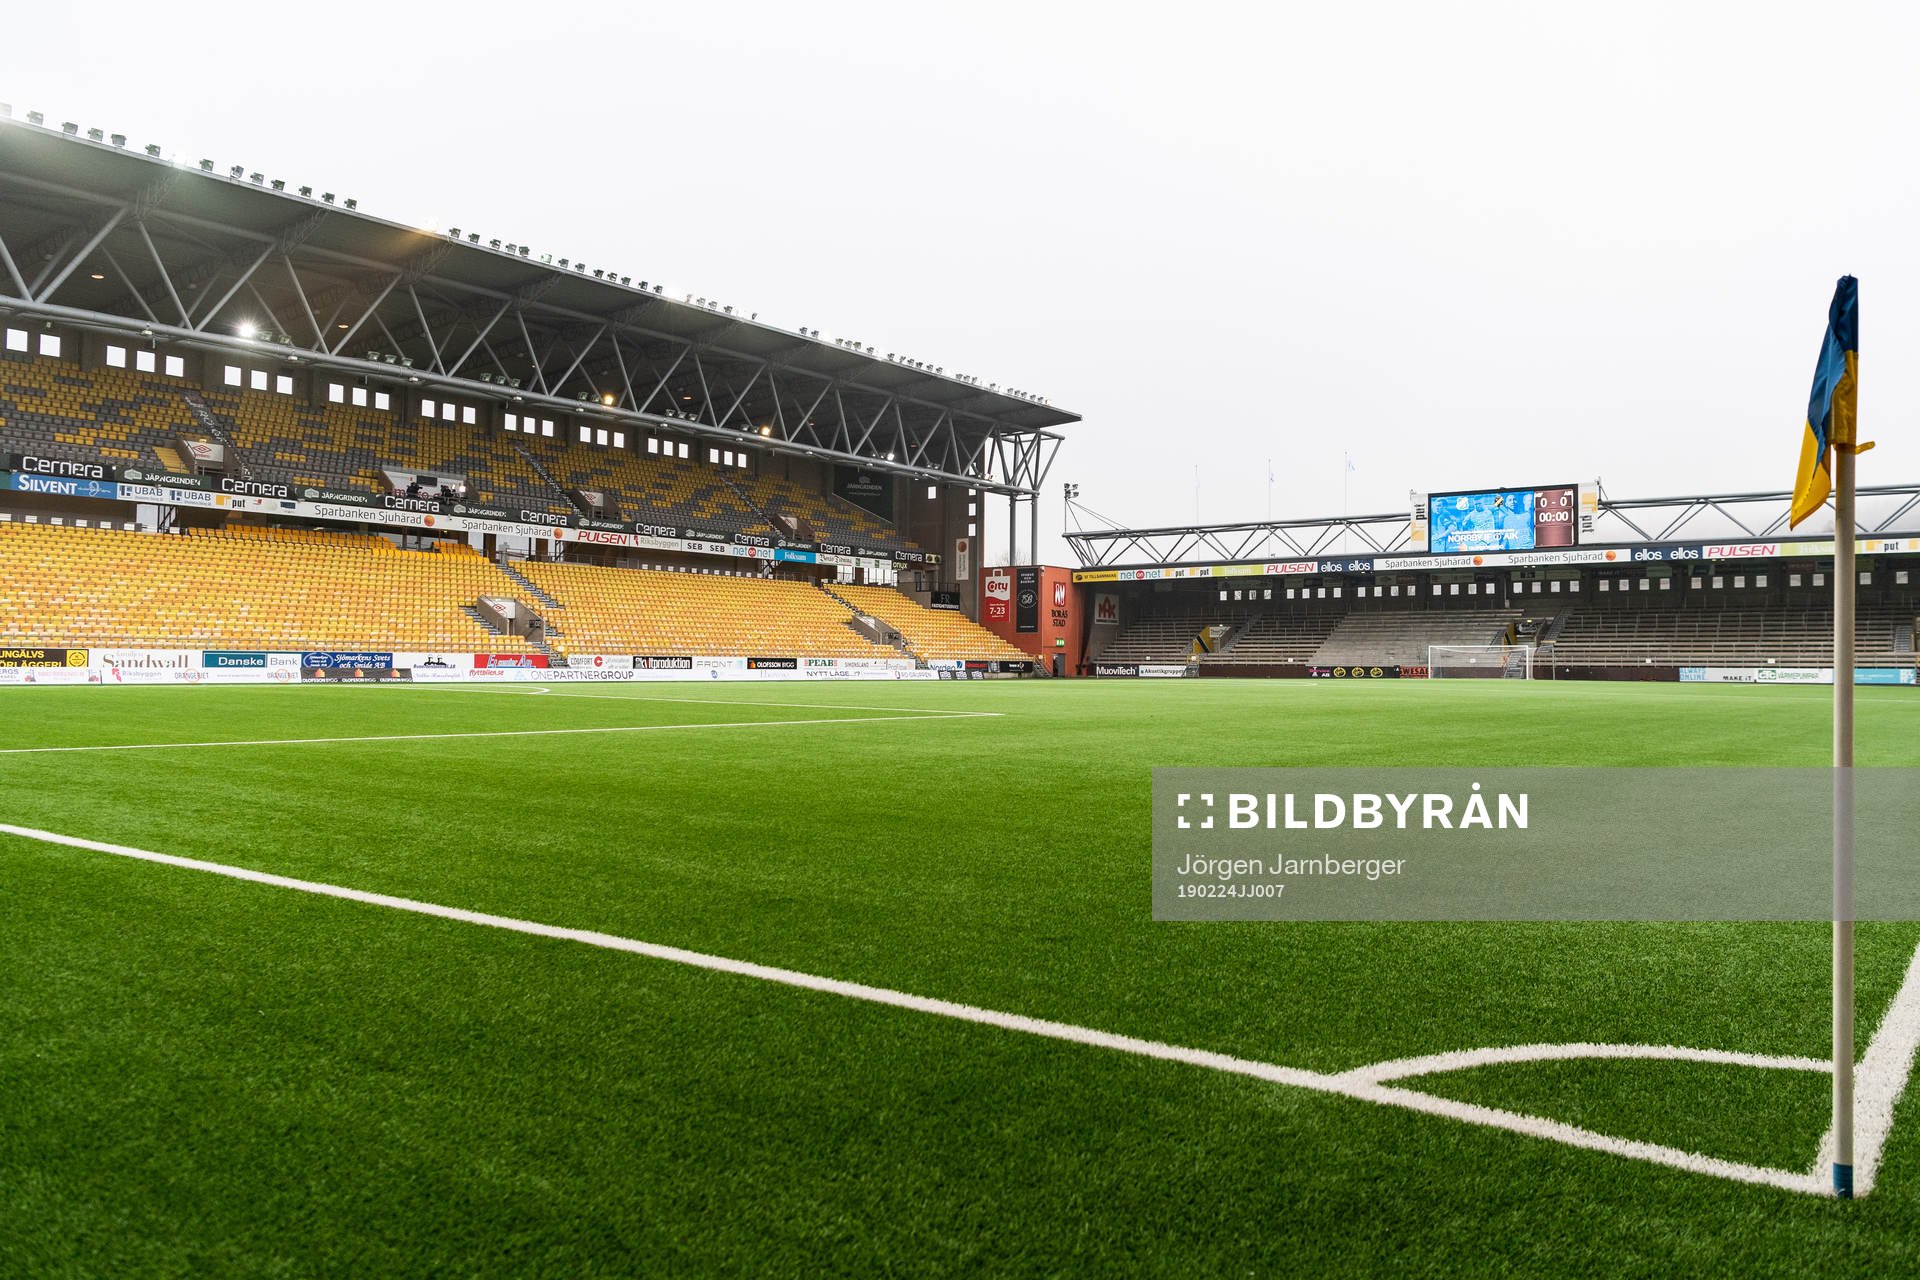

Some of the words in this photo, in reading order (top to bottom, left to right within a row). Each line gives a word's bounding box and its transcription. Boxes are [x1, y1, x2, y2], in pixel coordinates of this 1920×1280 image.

[22, 456, 103, 478] Cernera
[18, 474, 77, 495] SILVENT
[221, 478, 287, 498] Cernera
[134, 486, 163, 497] UBAB
[184, 491, 211, 501] UBAB
[232, 498, 245, 508] put
[384, 495, 439, 512] Cernera
[1540, 497, 1547, 508] 0
[1560, 496, 1567, 507] 0
[314, 505, 376, 520] Sparbanken
[379, 510, 422, 525] Sjuhärad
[520, 510, 567, 526] Cernera
[1414, 503, 1427, 521] put
[1539, 511, 1569, 523] 00:00
[462, 519, 513, 532] Sparbanken
[516, 525, 552, 537] Sjuhärad
[636, 523, 676, 537] Cernera
[1579, 515, 1595, 533] put
[577, 531, 627, 545] PULSEN
[640, 537, 679, 548] Riksbyggen
[734, 533, 770, 547] Cernera
[820, 543, 851, 555] Cernera
[1707, 545, 1775, 557] PULSEN
[1884, 541, 1899, 552] put
[1508, 553, 1560, 564] Sparbanken
[1562, 552, 1603, 562] Sjuhärad
[1634, 548, 1662, 561] ellos
[1670, 546, 1699, 560] ellos
[893, 561, 908, 570] onyx
[1266, 563, 1314, 574] PULSEN
[1320, 561, 1342, 572] ellos
[1348, 560, 1370, 571] ellos
[1385, 559, 1432, 569] Sparbanken
[1434, 557, 1471, 567] Sjuhärad
[989, 607, 1006, 615] 7-23
[1051, 609, 1068, 619] BORÅS
[1052, 619, 1066, 628] STAD
[218, 656, 264, 666] Danske
[270, 656, 298, 666] Bank
[334, 654, 372, 663] Sjömarkens
[372, 655, 391, 663] Svets
[808, 659, 834, 667] PEAB
[1097, 666, 1136, 676] MuoviTech
